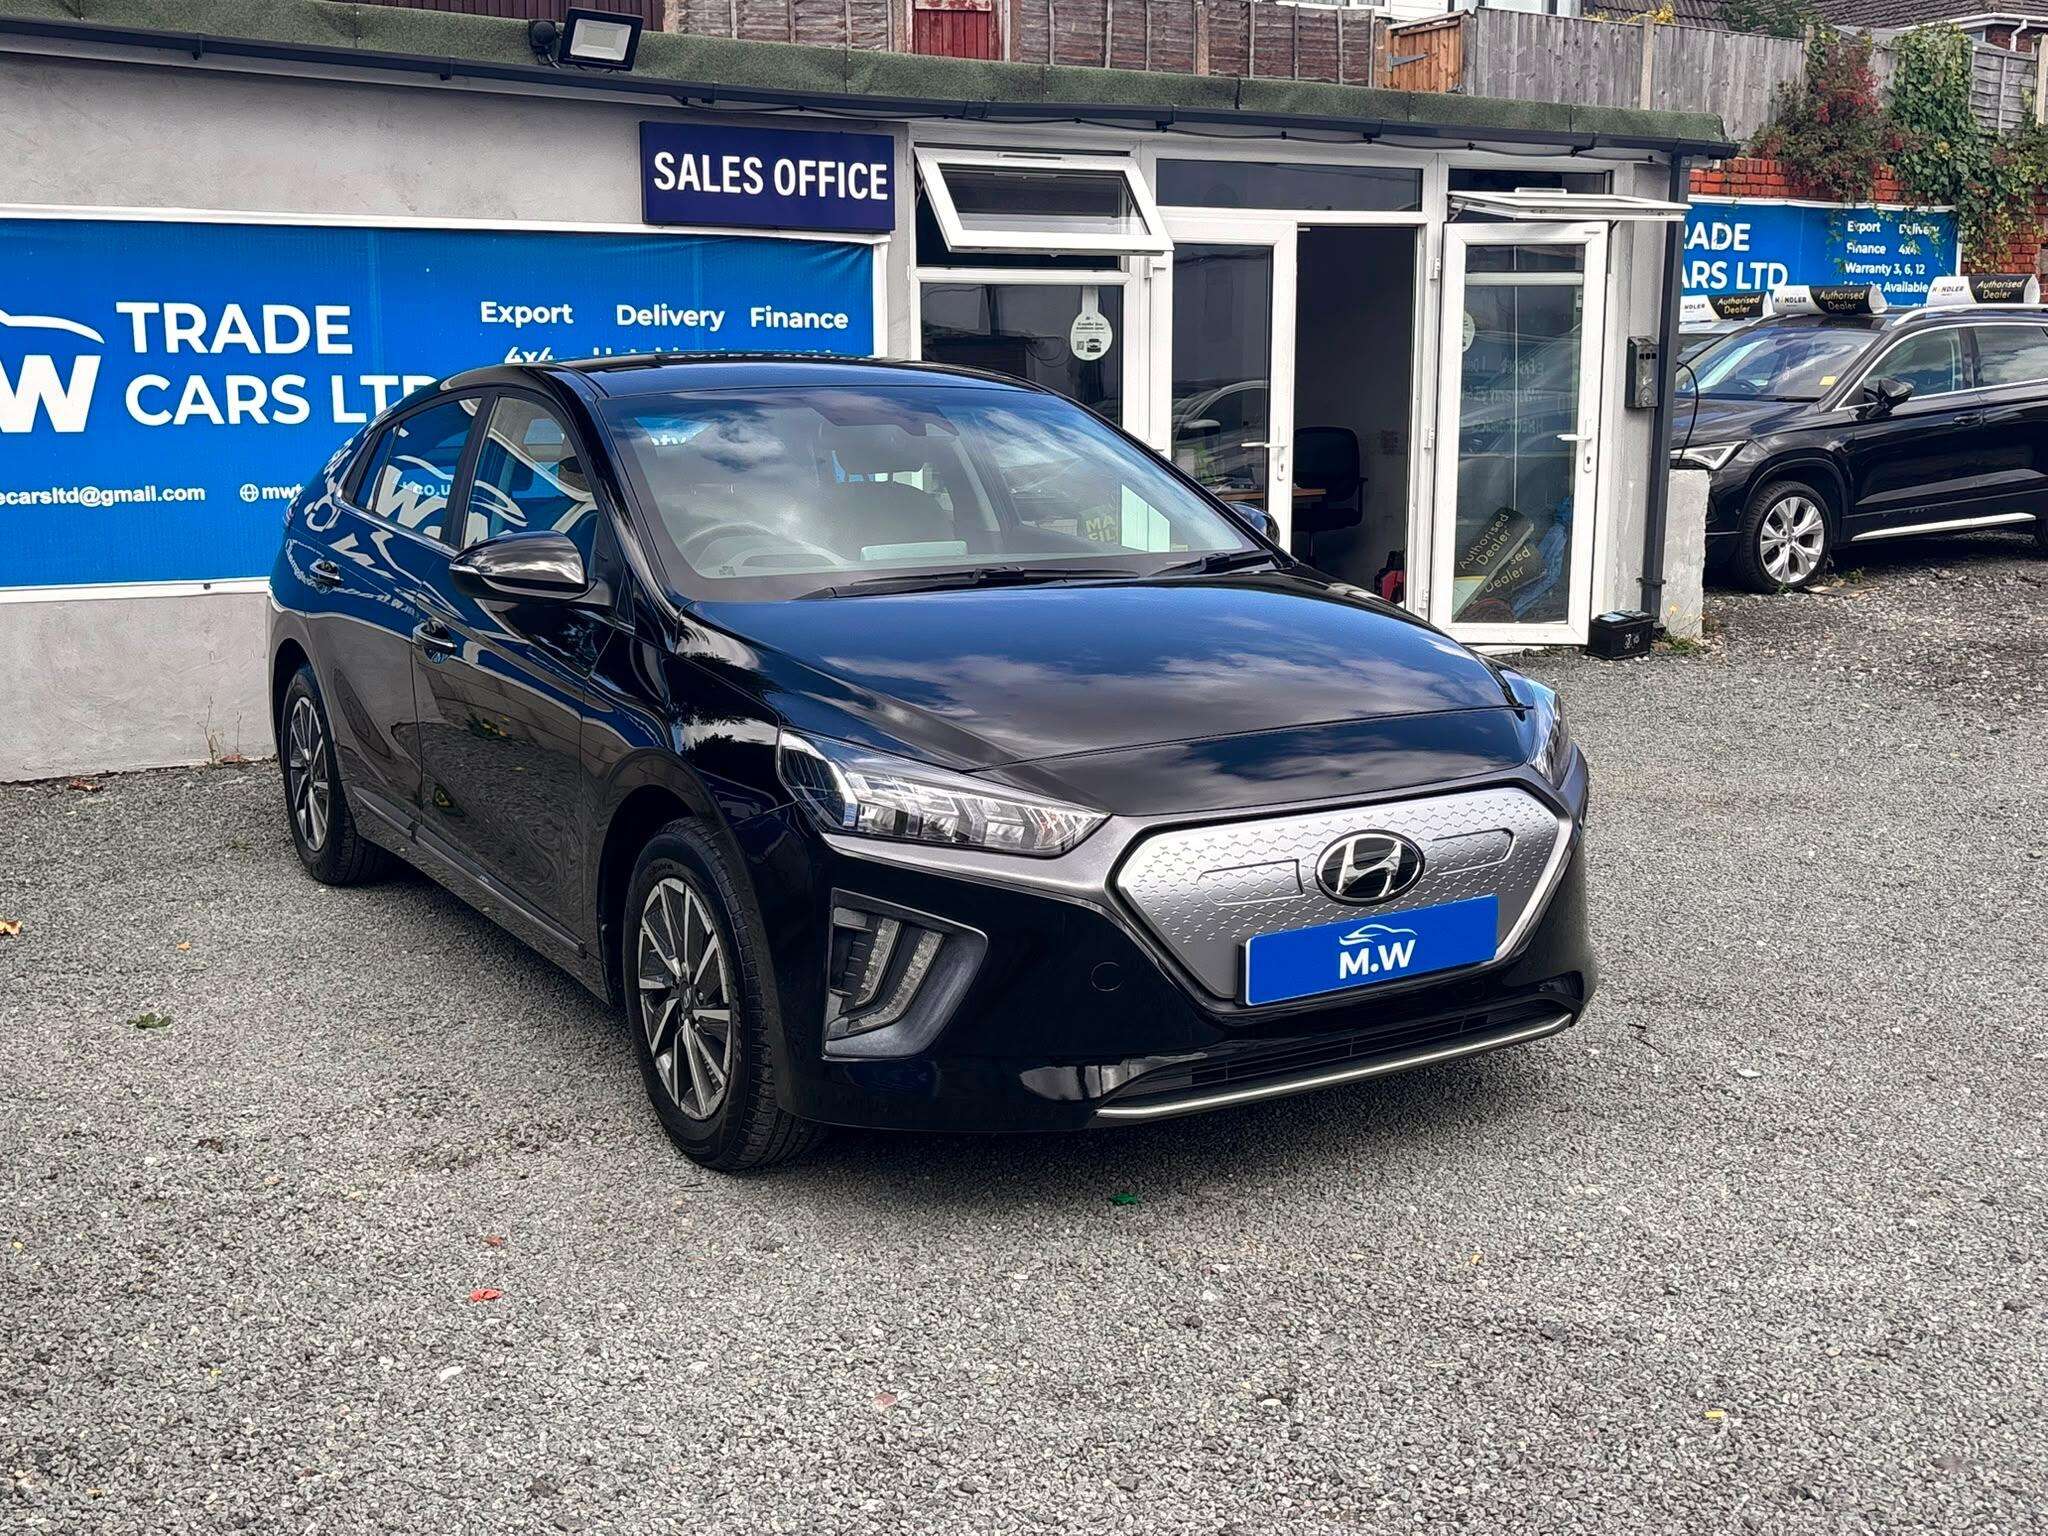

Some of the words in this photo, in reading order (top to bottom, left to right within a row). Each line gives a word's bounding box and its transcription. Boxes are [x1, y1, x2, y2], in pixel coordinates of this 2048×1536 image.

[654, 151, 764, 195] SALES
[774, 158, 888, 200] OFFICE
[1847, 220, 1881, 234] Export
[1846, 242, 1886, 254] Finance
[1898, 243, 1918, 255] 4x4
[1736, 261, 1788, 290] LTD
[1845, 262, 1892, 276] Warranty
[1893, 264, 1902, 275] 3,
[1904, 264, 1914, 276] 6,
[1915, 264, 1926, 275] 12
[1883, 281, 1929, 293] Available
[1977, 279, 2025, 289] Authorised
[1717, 295, 1761, 305] Authorised
[1819, 290, 1866, 300] Authorised
[1983, 289, 2011, 299] Dealer
[1724, 305, 1751, 315] Dealer
[1827, 300, 1856, 310] Dealer
[480, 302, 574, 328] Export
[616, 304, 725, 332] Delivery
[750, 305, 848, 330] Finance
[116, 302, 353, 355] TRADE
[504, 346, 553, 363] 4x4
[125, 374, 310, 427] CARS
[1459, 513, 1509, 569] Authorised
[1475, 528, 1512, 566] Dealer
[1484, 566, 1526, 593] Dealer
[1339, 939, 1416, 979] M.W
